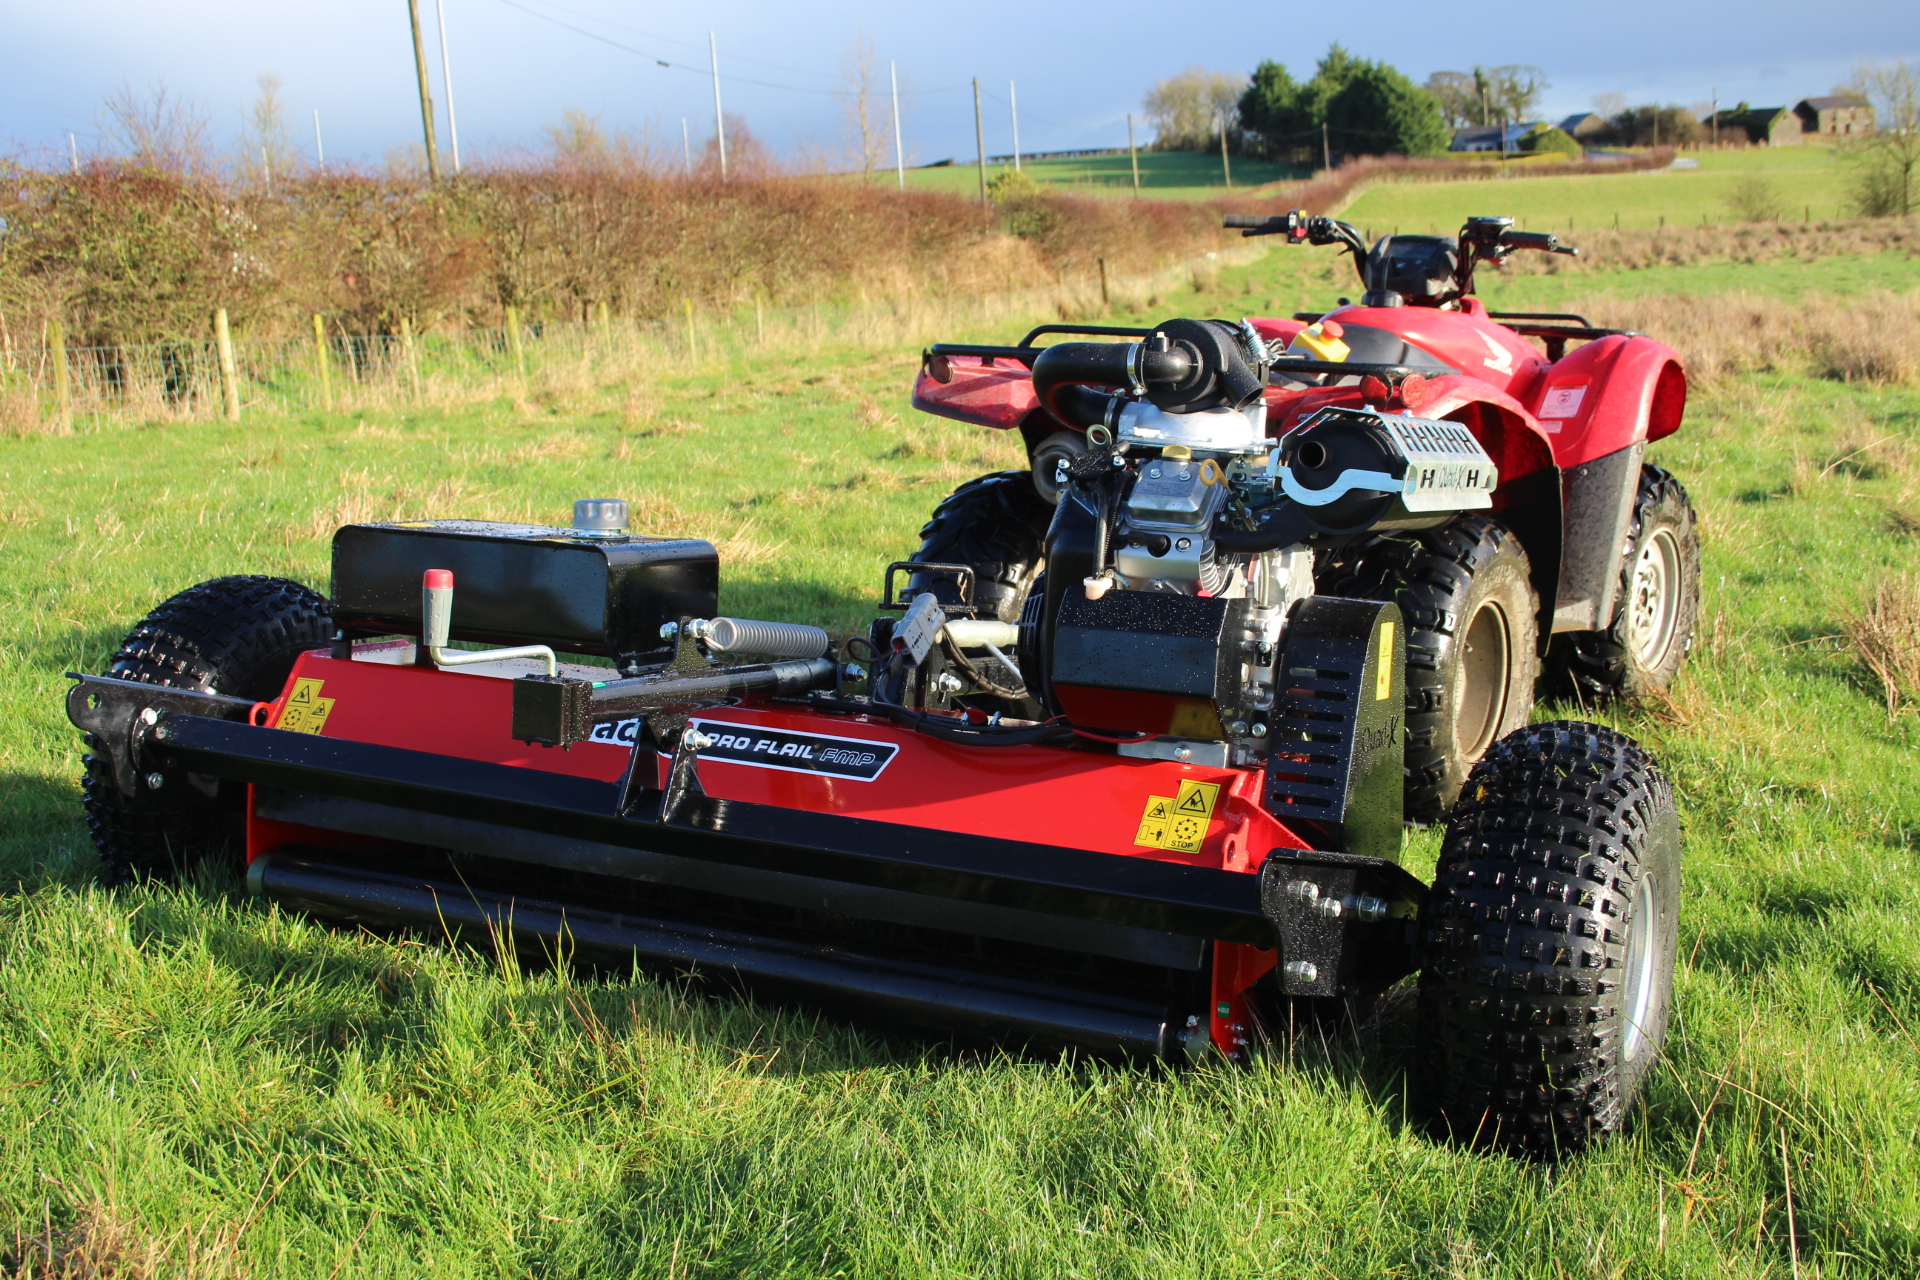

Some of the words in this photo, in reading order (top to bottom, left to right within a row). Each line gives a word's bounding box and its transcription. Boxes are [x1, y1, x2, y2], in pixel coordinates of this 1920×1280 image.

[1483, 357, 1513, 376] HONDA
[706, 732, 751, 750] PRO
[753, 739, 814, 759] FLAIL
[819, 747, 876, 766] FMP
[1171, 840, 1194, 849] STOP
